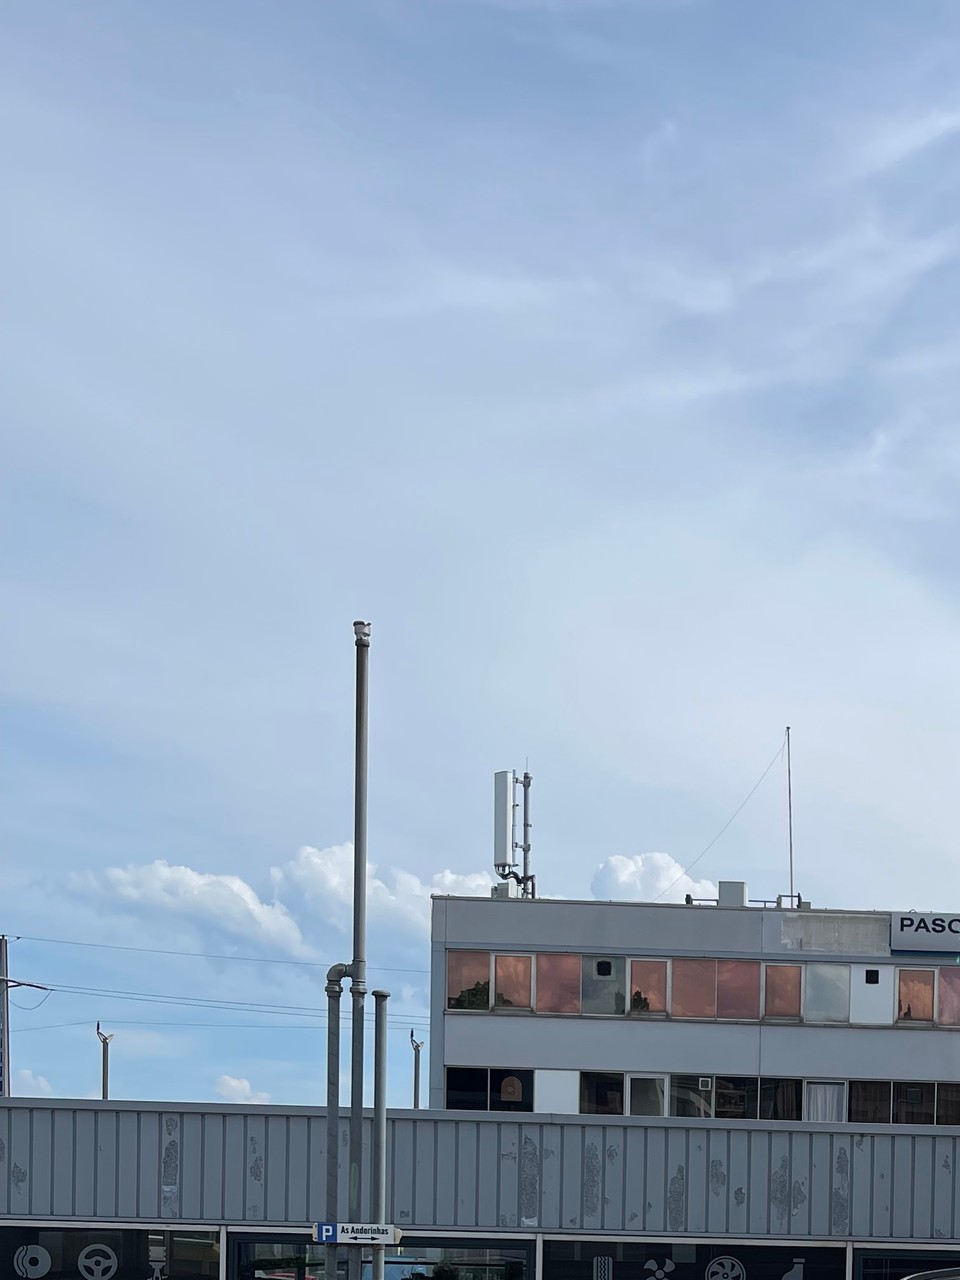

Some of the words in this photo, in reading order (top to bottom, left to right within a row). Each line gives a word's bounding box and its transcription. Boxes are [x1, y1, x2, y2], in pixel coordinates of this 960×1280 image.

[322, 1225, 333, 1241] P
[341, 1226, 349, 1234] As
[350, 1226, 389, 1235] Andorinhas
